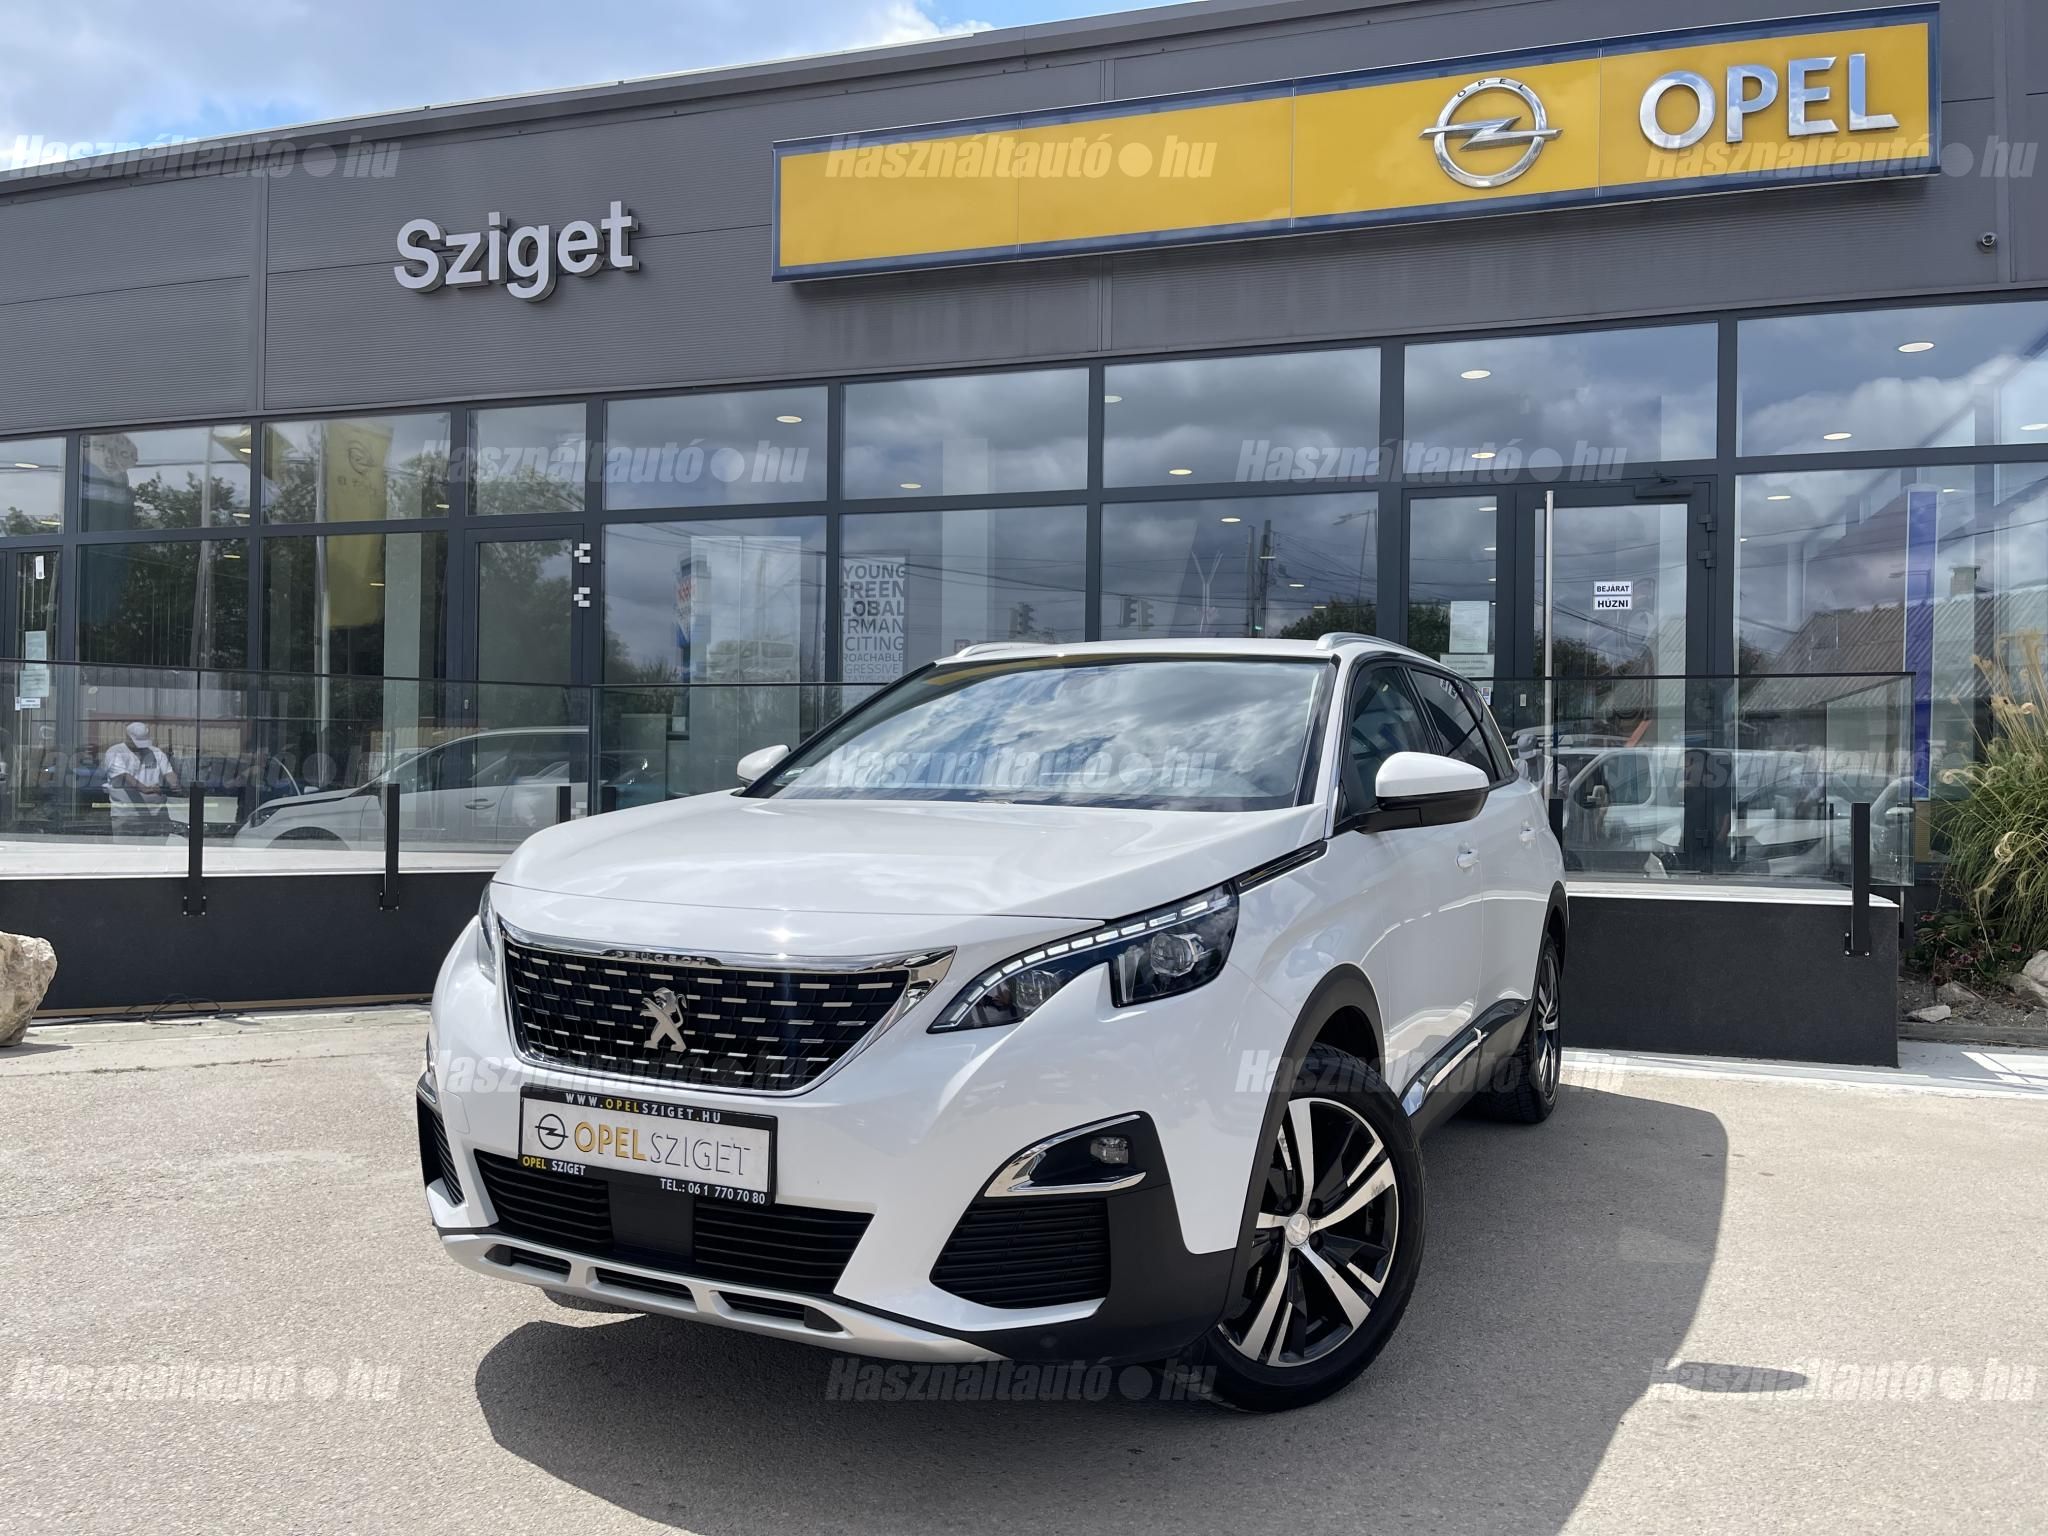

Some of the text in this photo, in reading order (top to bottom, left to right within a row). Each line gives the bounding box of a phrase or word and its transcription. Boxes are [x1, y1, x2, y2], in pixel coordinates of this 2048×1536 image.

[1457, 78, 1524, 97] OPEL
[1640, 53, 1899, 149] OPEL
[394, 201, 637, 301] Sziget
[843, 600, 904, 617] LOBAL
[522, 1156, 586, 1176] OPEL SZIGET
[715, 1187, 734, 1200] 770
[736, 1190, 750, 1202] 70
[752, 1192, 766, 1204] 80
